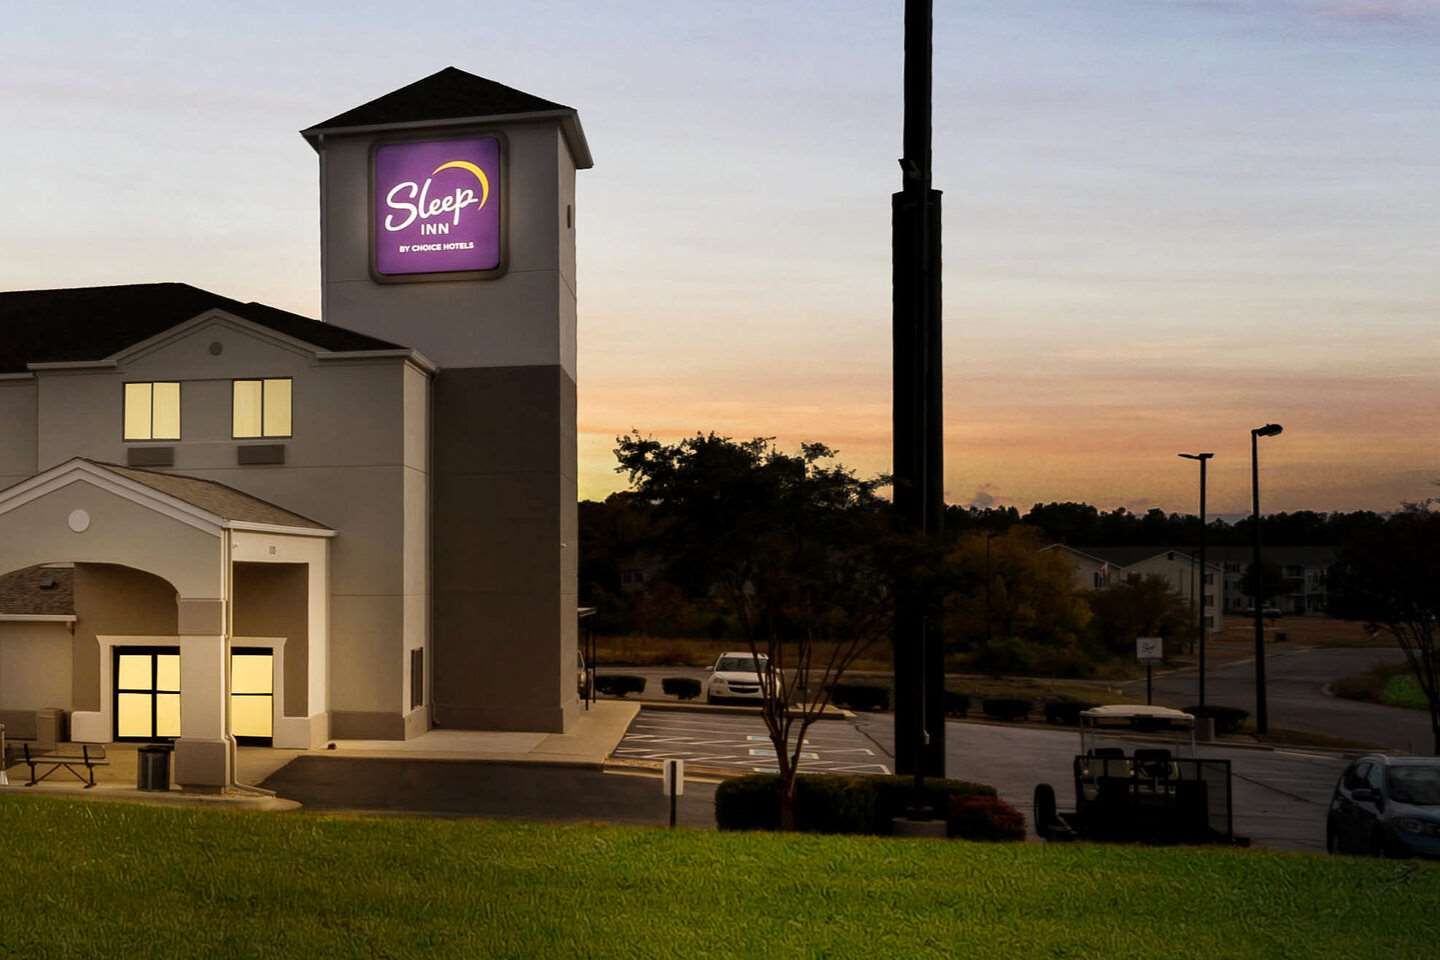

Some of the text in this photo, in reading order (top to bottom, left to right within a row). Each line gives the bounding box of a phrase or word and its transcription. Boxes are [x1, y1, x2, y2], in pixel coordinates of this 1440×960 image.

[384, 178, 479, 232] Sleep
[420, 222, 450, 236] INN
[399, 241, 475, 253] BY CHOICE HOTELS
